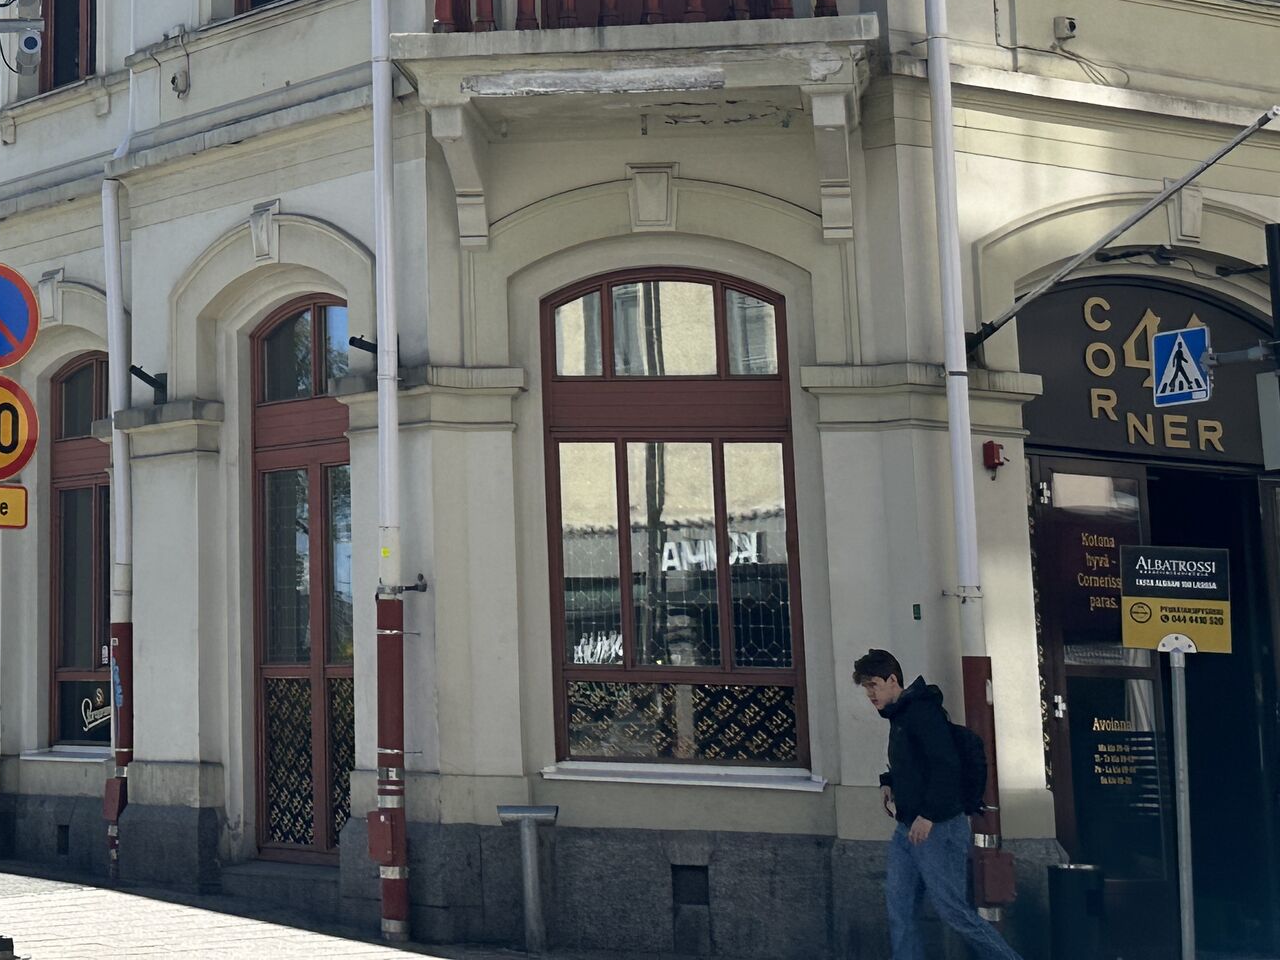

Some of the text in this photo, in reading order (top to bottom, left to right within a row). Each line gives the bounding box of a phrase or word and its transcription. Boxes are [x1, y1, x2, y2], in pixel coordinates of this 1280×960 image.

[1081, 532, 1115, 548] Kotona
[1135, 556, 1216, 574] ALBATROSSI
[1077, 573, 1121, 589] Corneriss
